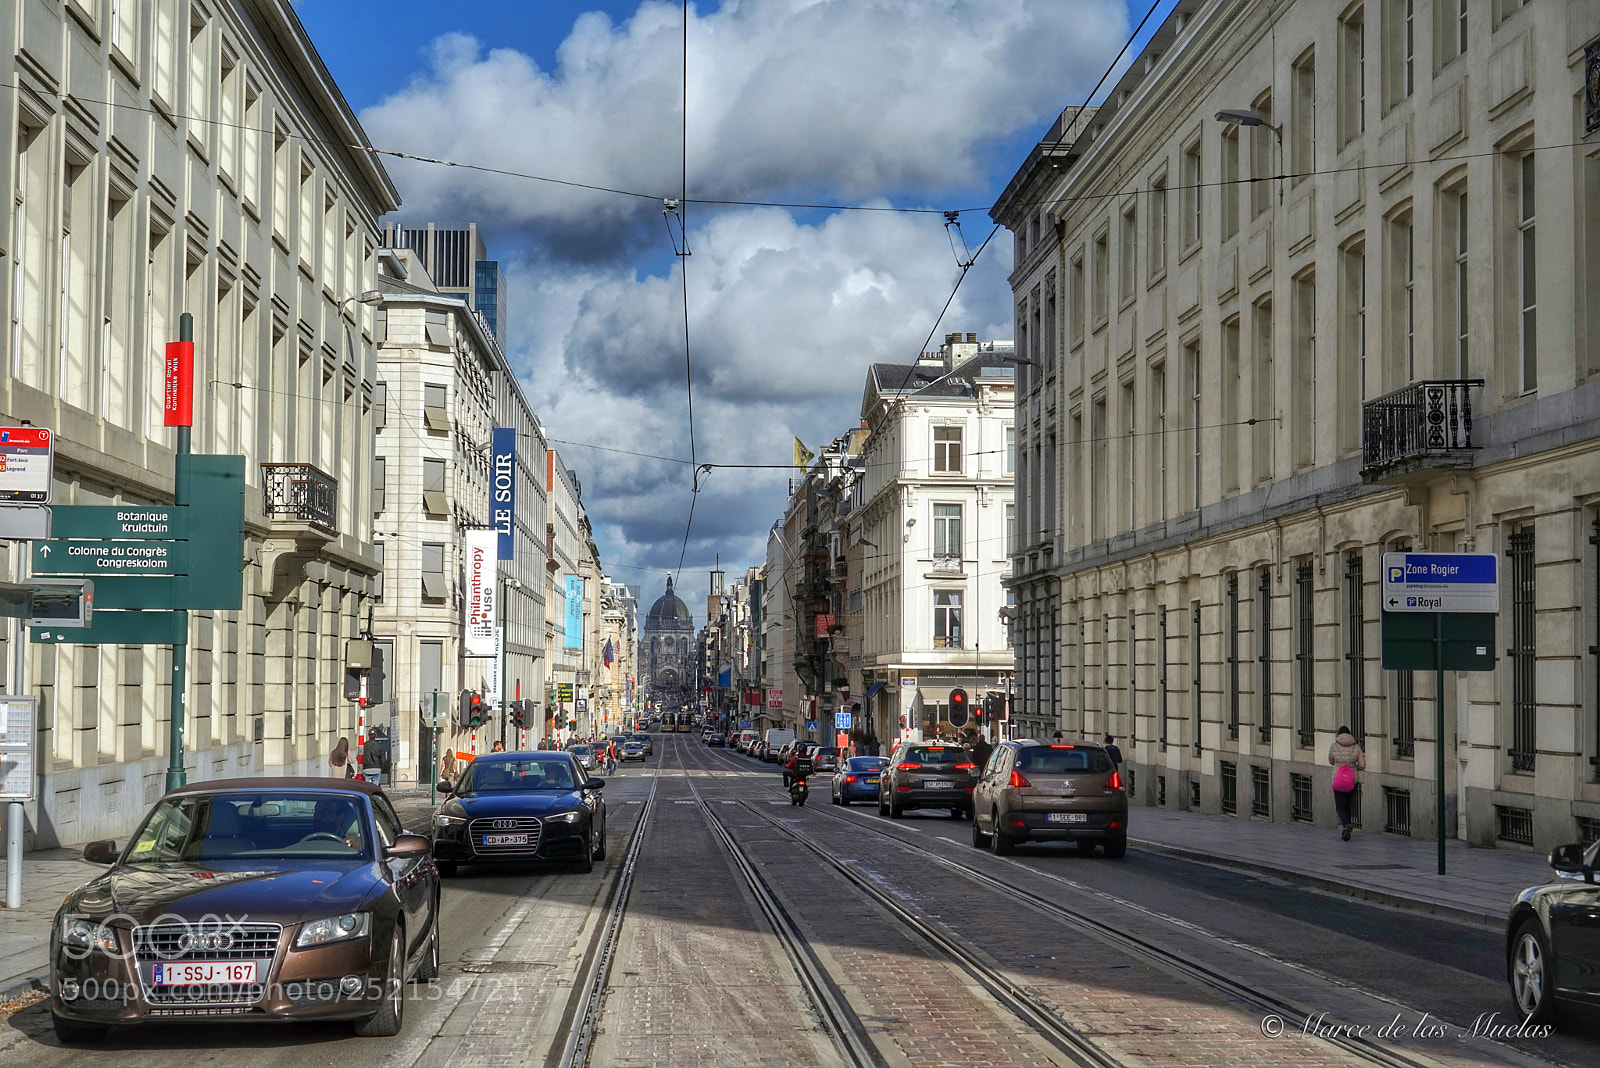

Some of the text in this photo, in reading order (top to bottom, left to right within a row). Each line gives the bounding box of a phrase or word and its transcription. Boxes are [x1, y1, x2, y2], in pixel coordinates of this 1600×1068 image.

[495, 452, 512, 536] LE SOIR
[117, 512, 168, 522] Botanique
[122, 523, 168, 532] Kruidtuin
[68, 546, 167, 558] Colonne du Congrès
[96, 558, 168, 568] Congreskolom
[1406, 564, 1428, 574] Zone
[1430, 564, 1459, 576] Rogier
[470, 546, 484, 625] Philanthropy
[1418, 597, 1442, 609] Royal
